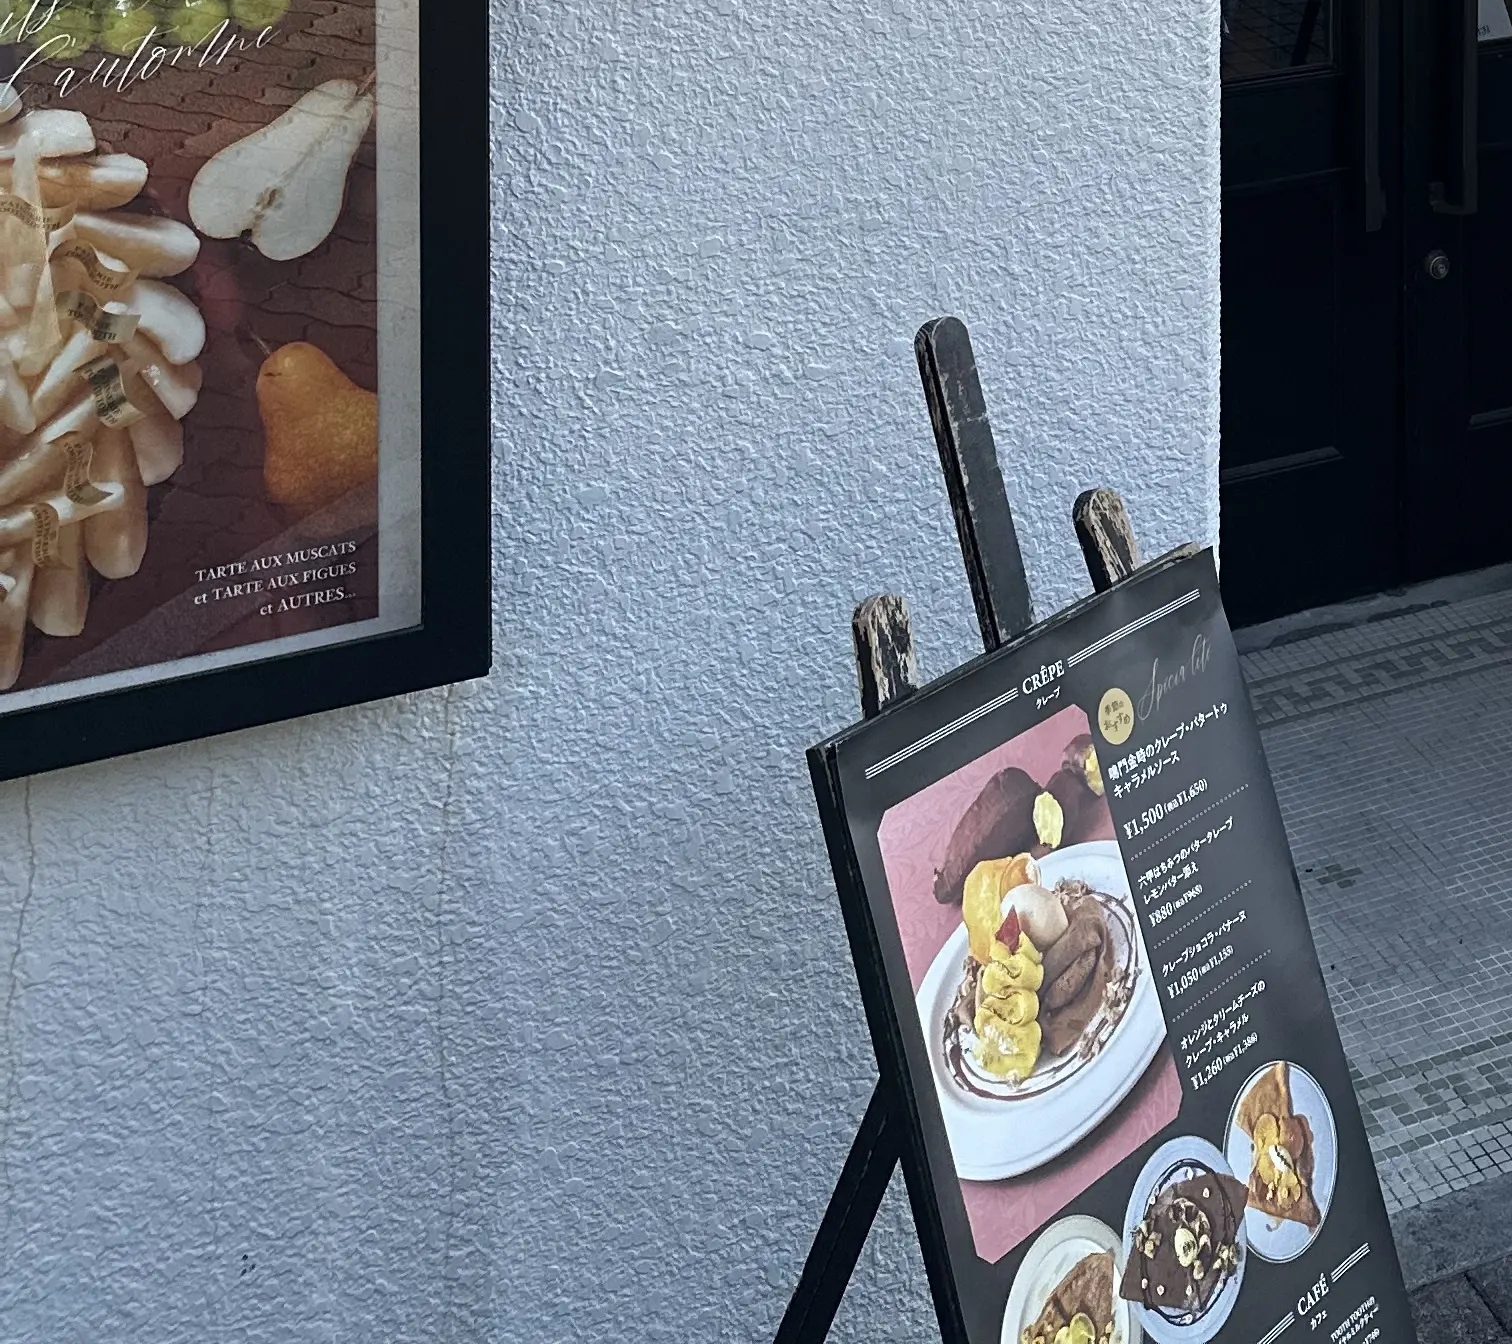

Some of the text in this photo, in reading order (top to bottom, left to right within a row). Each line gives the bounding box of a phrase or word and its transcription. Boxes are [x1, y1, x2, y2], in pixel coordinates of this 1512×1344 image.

[195, 541, 357, 583] TARTE AUX MUSCATS
[194, 562, 357, 605] et TARTE AUX FIGUES
[260, 603, 273, 616] et
[1022, 659, 1065, 695] CRÊPE
[1035, 686, 1061, 710] クレープ
[1113, 750, 1181, 799] キャラメルソース
[1123, 803, 1164, 840] ¥1,500
[1167, 967, 1199, 999] ¥1,050
[1190, 1056, 1223, 1091] ¥1,260
[1297, 1272, 1330, 1316] CAFÉ
[1309, 1310, 1328, 1331] カフェ
